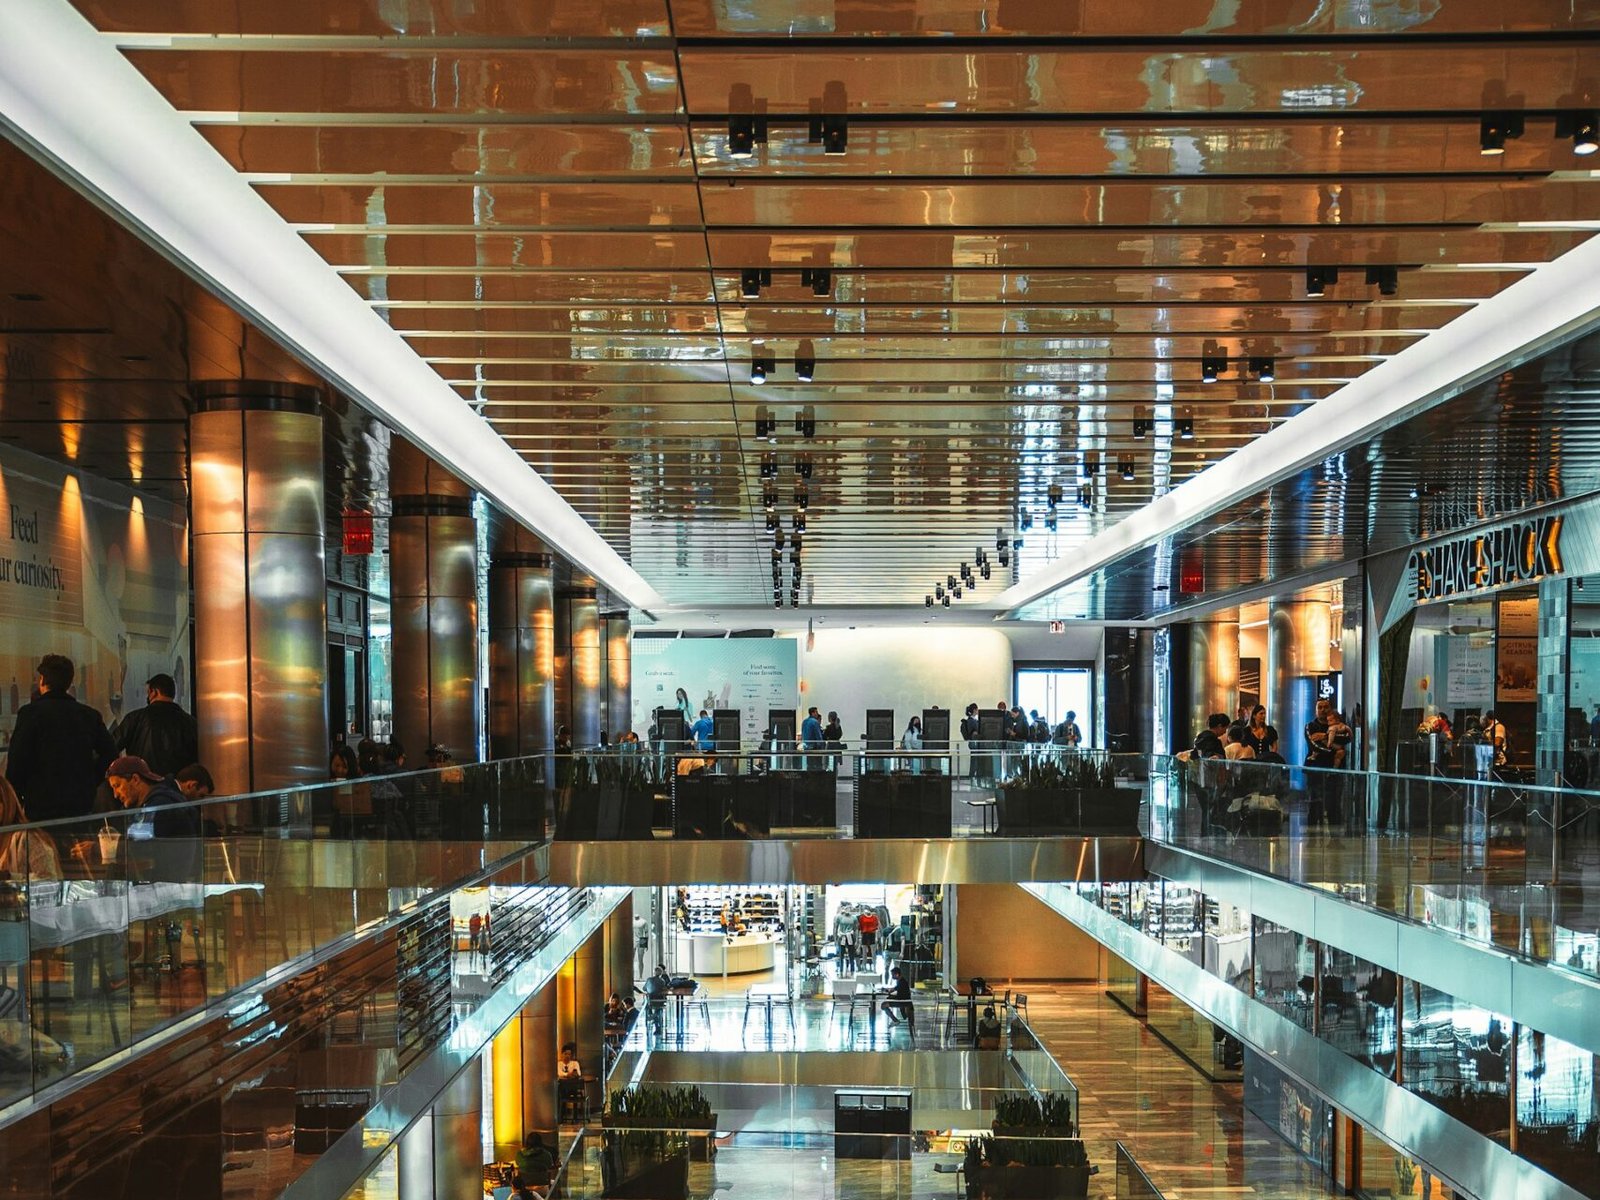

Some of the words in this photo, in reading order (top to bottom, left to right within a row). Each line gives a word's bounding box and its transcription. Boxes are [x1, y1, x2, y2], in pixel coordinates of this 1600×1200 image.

[10, 503, 39, 545] Feed
[14, 554, 64, 600] curiosity.
[1424, 537, 1478, 599] SHAKE
[1481, 515, 1552, 587] SHACK
